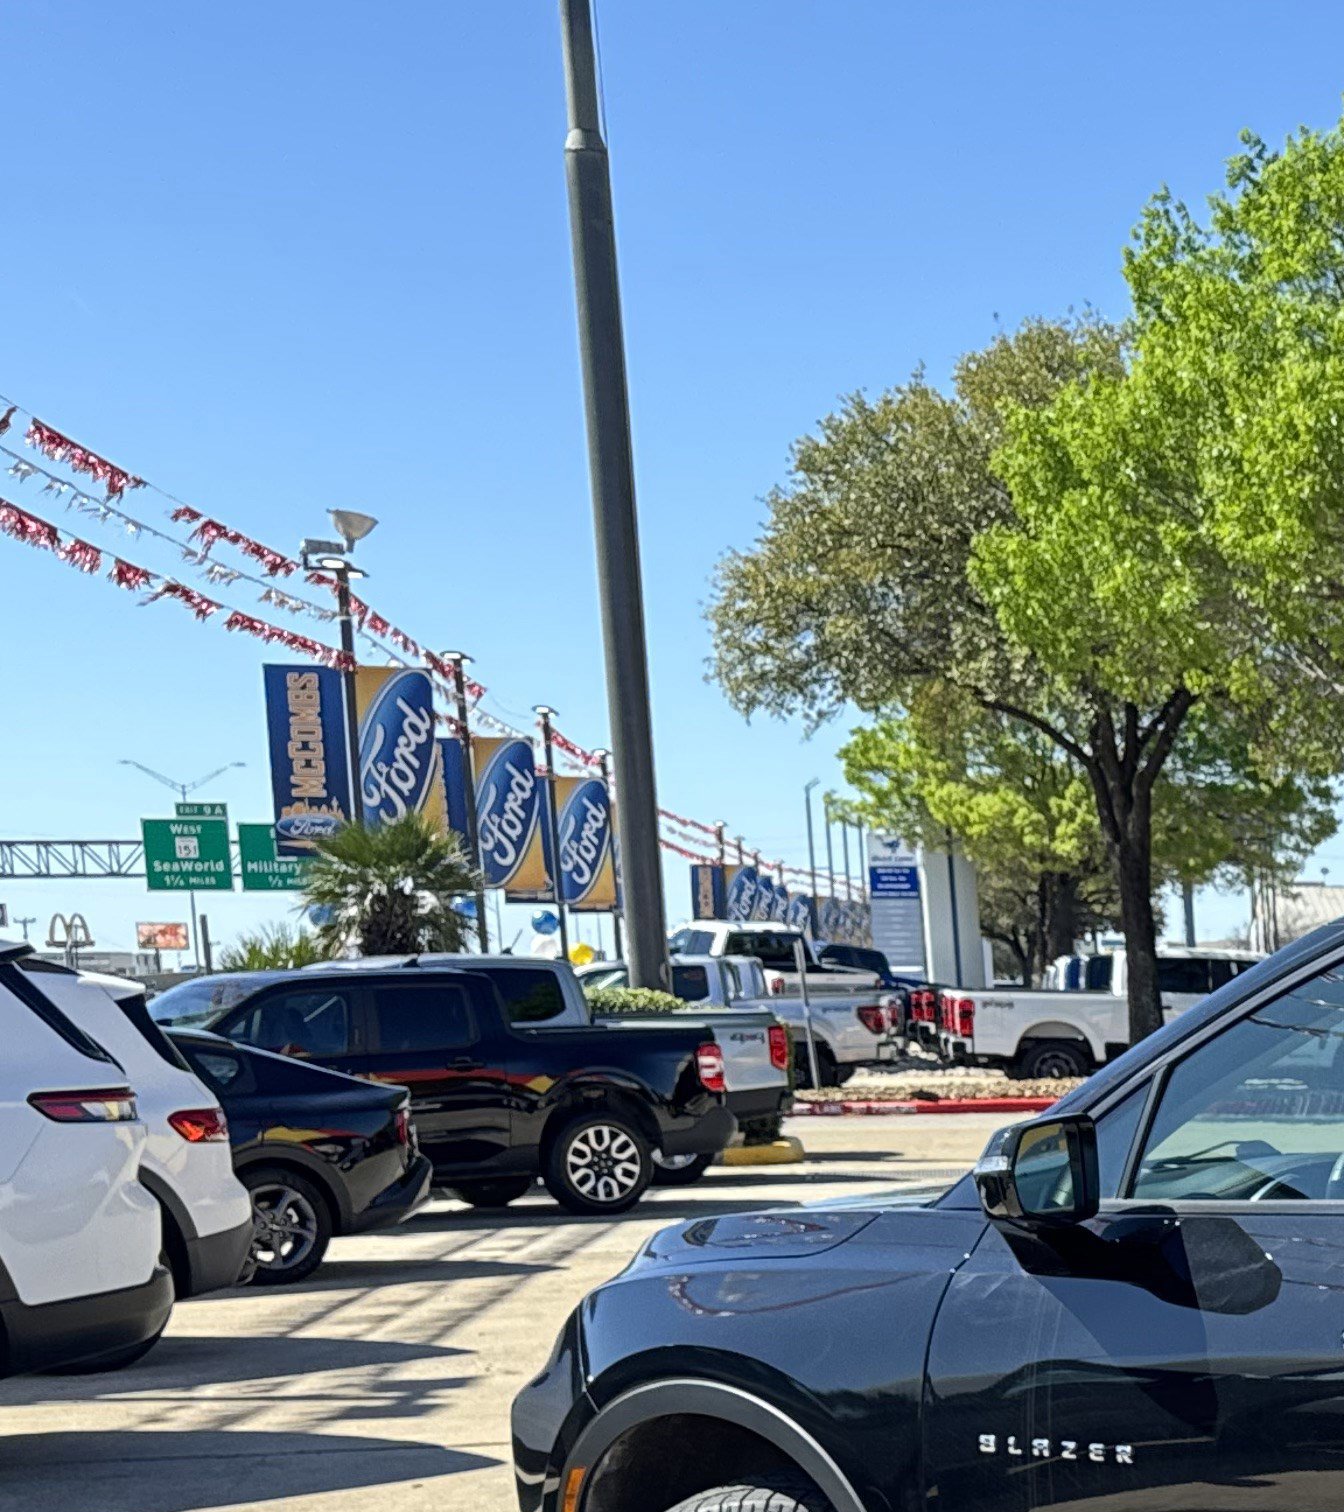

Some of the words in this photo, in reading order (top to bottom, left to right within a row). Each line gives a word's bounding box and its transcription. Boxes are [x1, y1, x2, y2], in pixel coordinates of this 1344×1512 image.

[362, 696, 431, 826] Ford
[214, 805, 224, 815] A
[480, 760, 535, 867] Ford
[177, 844, 198, 857] 151
[560, 797, 607, 885] Ford
[153, 859, 225, 873] SeaWorld
[246, 860, 302, 876] Military
[978, 1434, 1134, 1464] BLAZER
